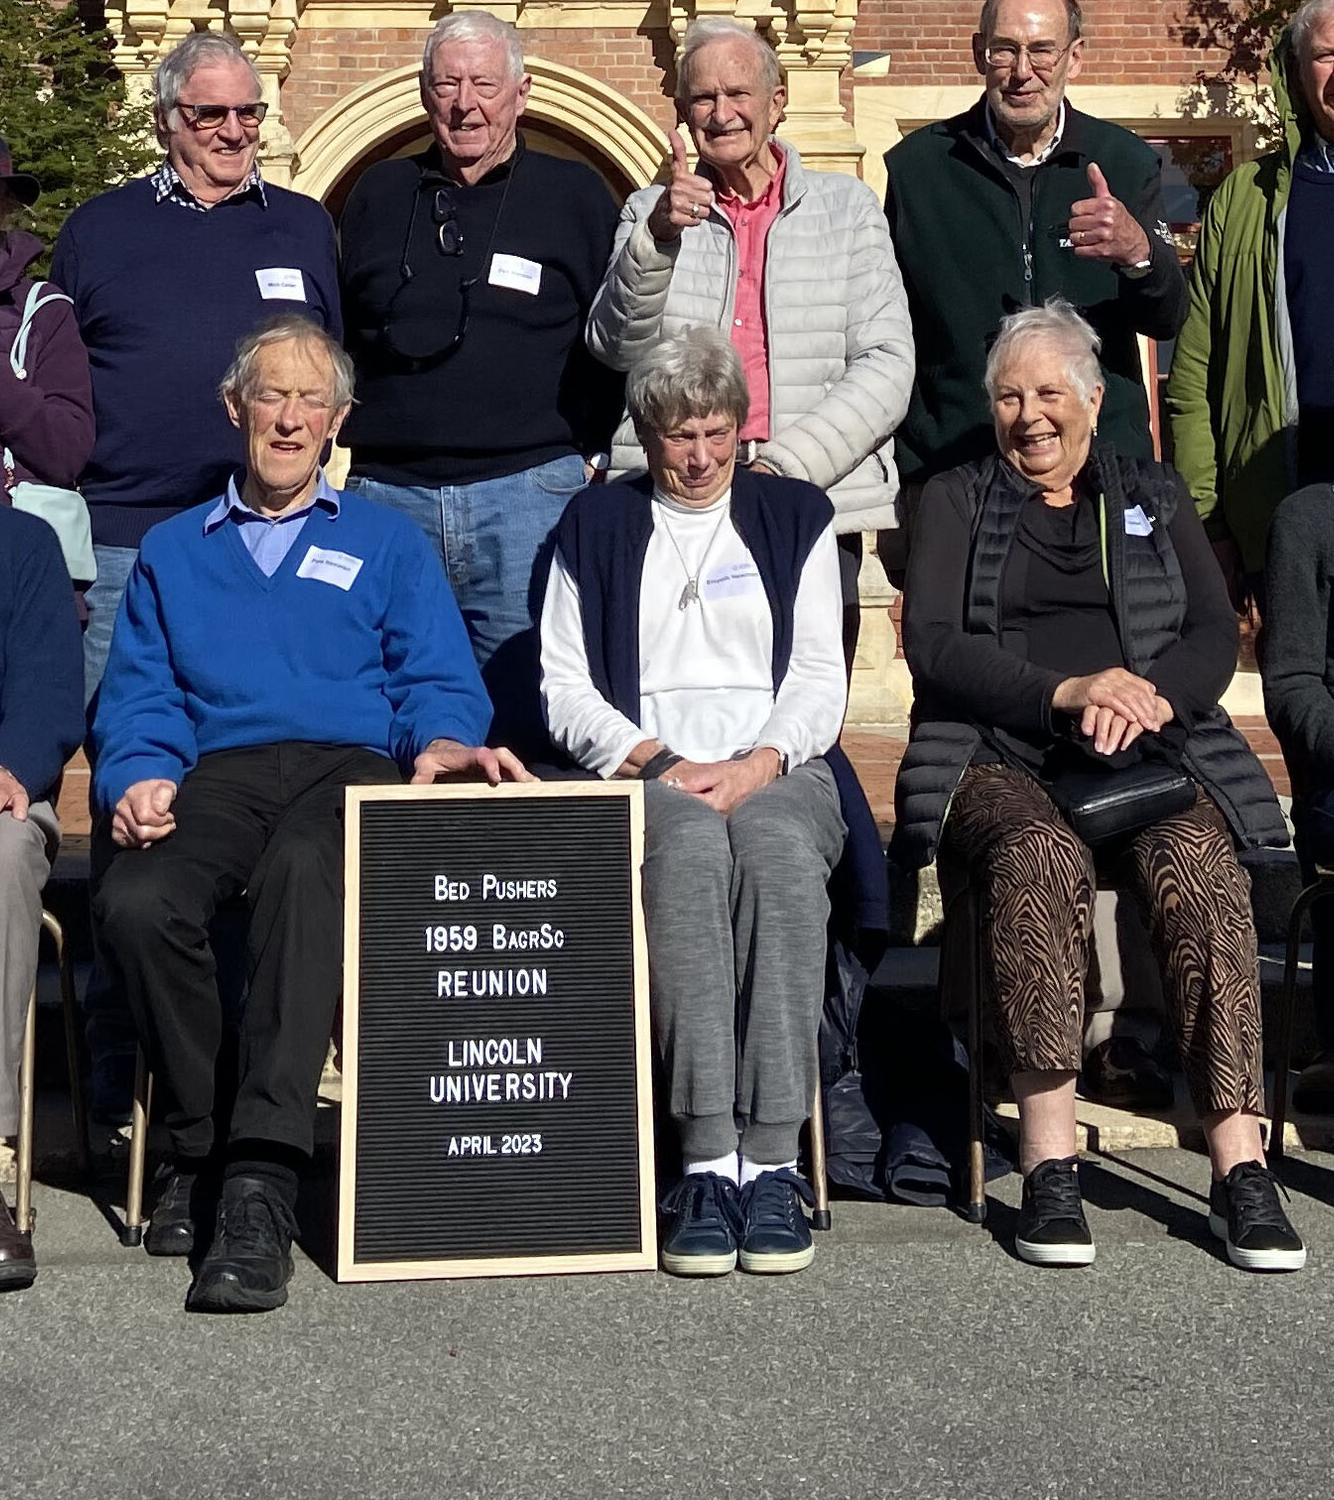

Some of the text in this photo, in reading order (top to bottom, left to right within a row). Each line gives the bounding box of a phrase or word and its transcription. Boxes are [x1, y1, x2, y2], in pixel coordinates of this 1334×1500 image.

[425, 924, 478, 953] 1959
[437, 968, 548, 997] REUNION
[448, 1037, 542, 1067] LINCOLN
[430, 1071, 573, 1102] UNIVERSITY
[447, 1133, 543, 1156] APRIL 2023
